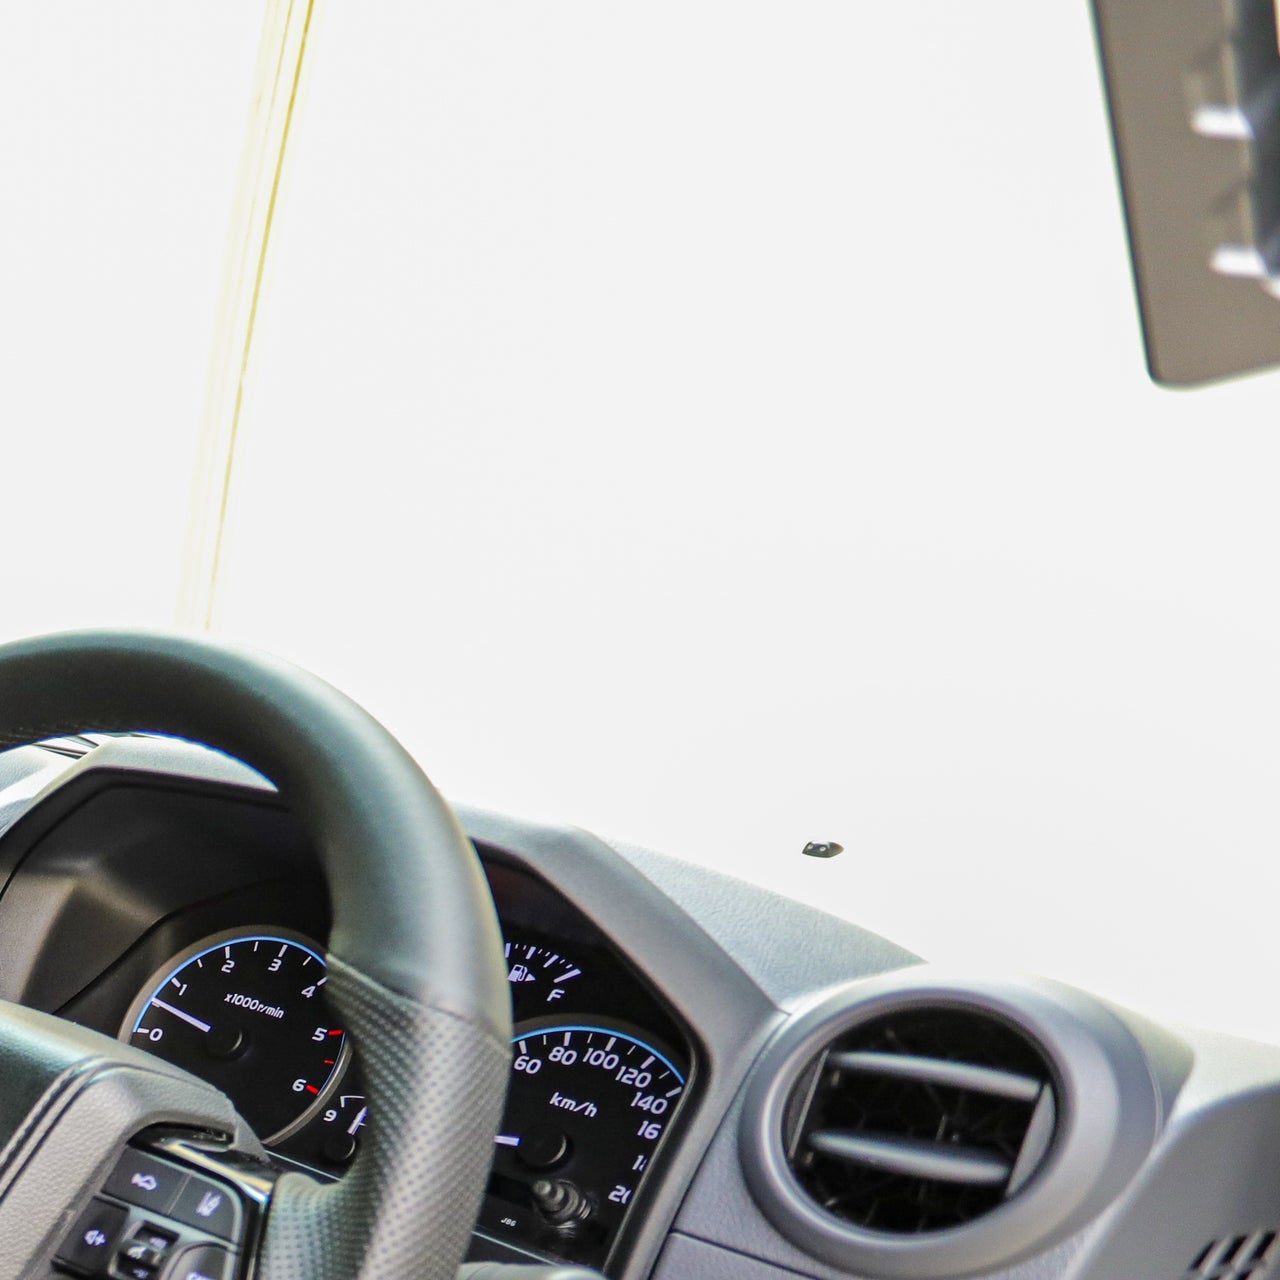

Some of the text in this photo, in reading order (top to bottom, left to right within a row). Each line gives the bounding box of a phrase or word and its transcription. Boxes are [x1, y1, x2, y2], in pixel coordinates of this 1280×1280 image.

[221, 959, 236, 974] 2
[267, 958, 282, 972] 3
[178, 983, 188, 996] 1
[301, 985, 316, 999] 4
[546, 988, 566, 1002] F
[149, 1027, 163, 1042] 0
[311, 1027, 328, 1042] 5
[548, 1046, 578, 1066] 80
[582, 1047, 620, 1070] 100
[513, 1055, 542, 1075] 60
[615, 1065, 652, 1088] 120
[292, 1078, 307, 1092] 6
[549, 1091, 598, 1118] km/h
[630, 1091, 668, 1115] 140
